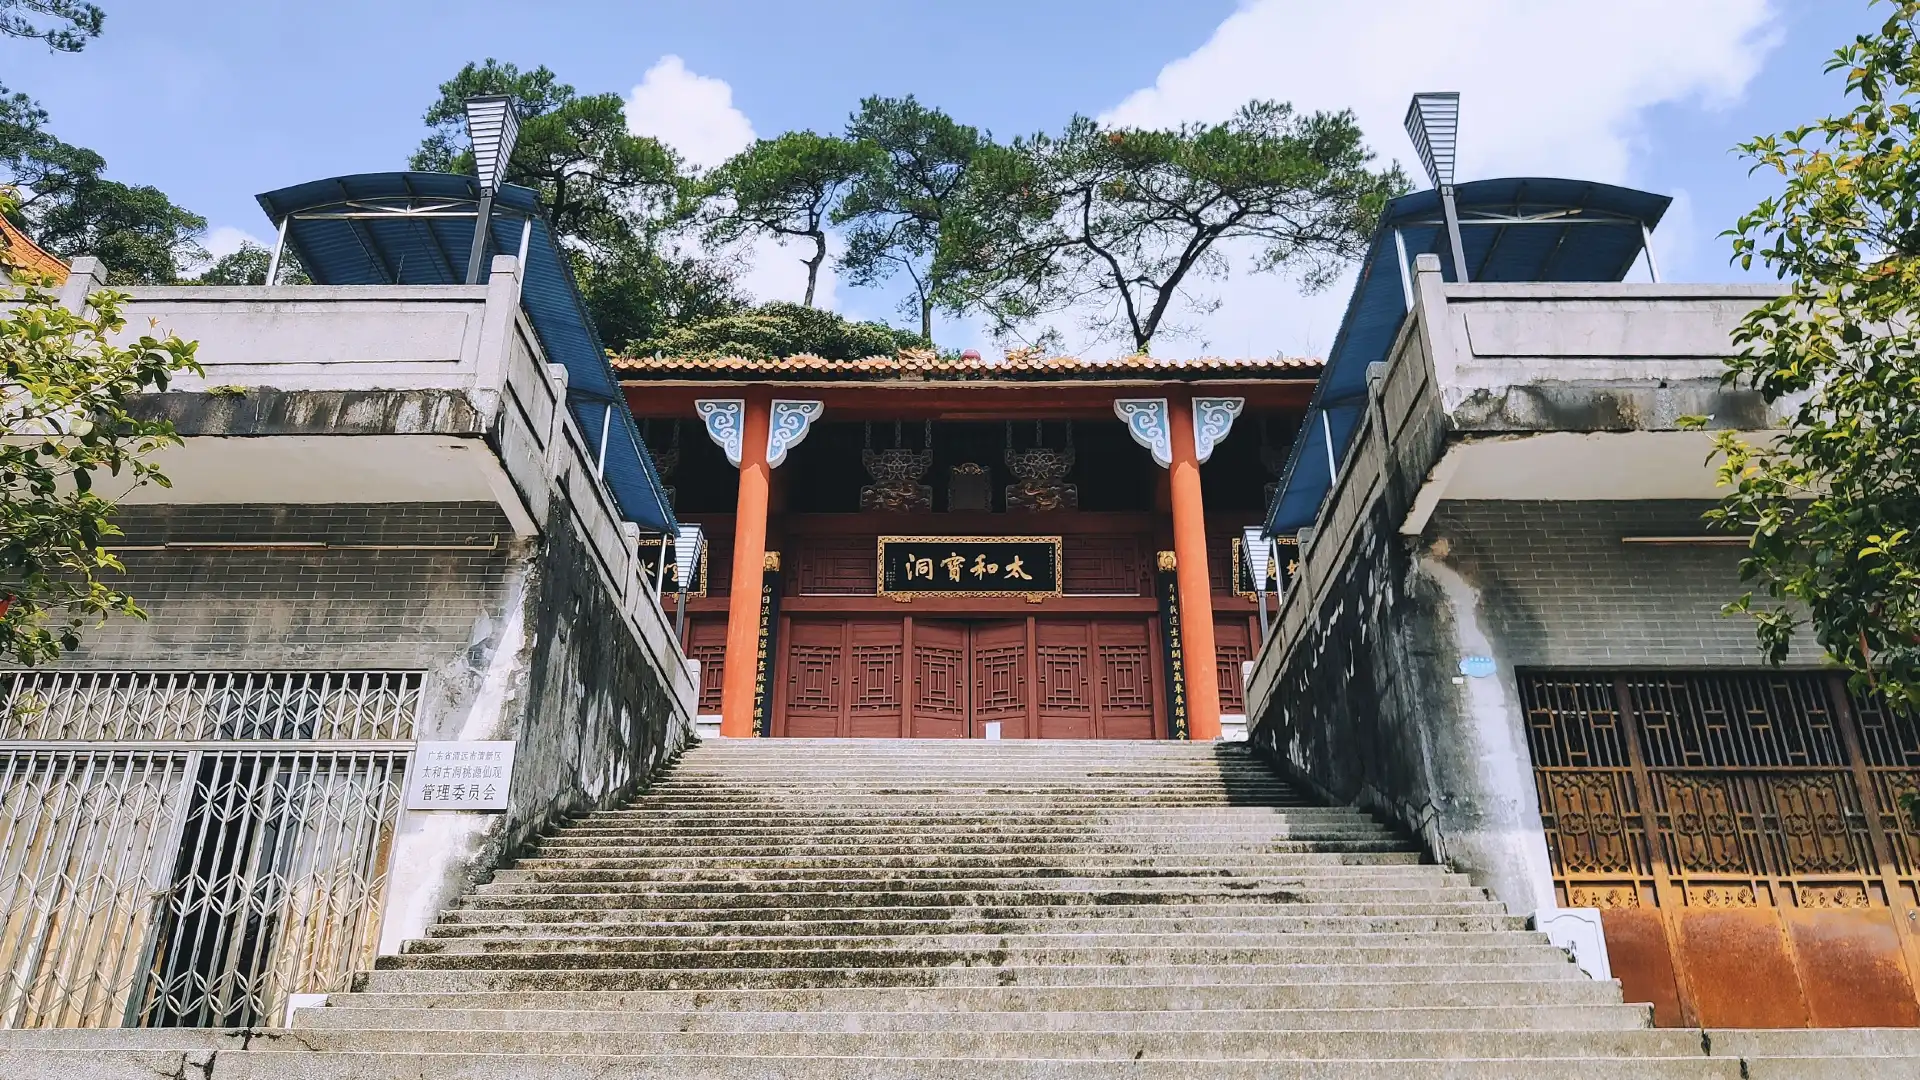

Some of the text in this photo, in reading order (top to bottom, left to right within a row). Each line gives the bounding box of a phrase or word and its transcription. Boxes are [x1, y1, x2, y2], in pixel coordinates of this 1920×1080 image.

[427, 750, 503, 762] 广东省清远市清新区
[421, 765, 503, 779] 太和古洞桃源仙观
[421, 783, 497, 801] 管理委员会
